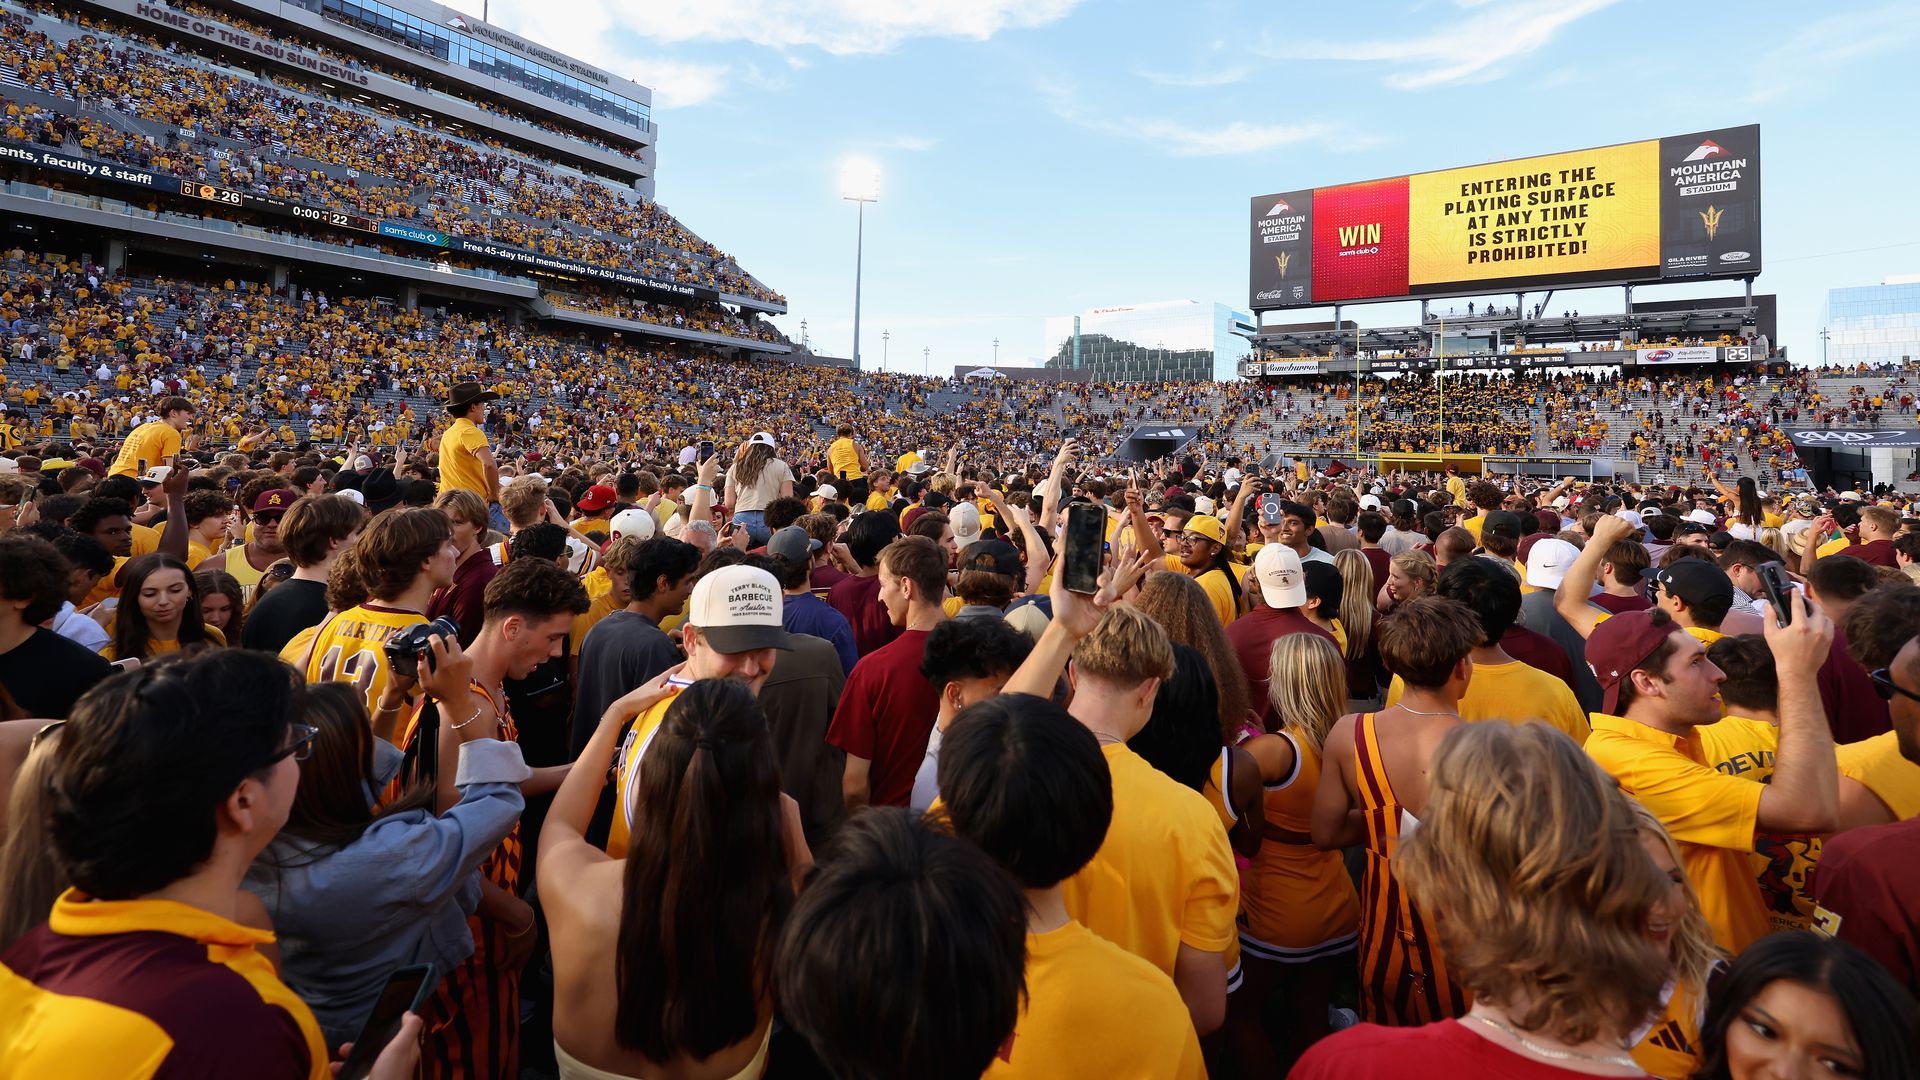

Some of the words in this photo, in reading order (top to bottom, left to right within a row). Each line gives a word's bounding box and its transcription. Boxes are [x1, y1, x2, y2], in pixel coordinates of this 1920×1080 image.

[137, 3, 189, 30] HOME
[192, 21, 215, 36] OF
[219, 30, 250, 49] THE
[253, 42, 284, 59] ASU
[286, 52, 317, 69] SUN
[320, 62, 369, 86] DEVILS
[472, 23, 525, 52] MOUNTAIN
[526, 45, 568, 69] AMERICA
[569, 62, 609, 85] STADIUM
[0, 147, 38, 163] ents,
[43, 153, 97, 175] faculty
[100, 166, 112, 177] &
[115, 169, 152, 184] staff!
[1670, 158, 1747, 177] MOUNTAIN
[1461, 172, 1551, 197] ENTERING
[1559, 166, 1596, 184] THE
[1675, 169, 1742, 186] AMERICA
[1686, 182, 1732, 195] STADIUM
[221, 191, 240, 203] 26
[1444, 195, 1521, 216] PLAYING
[1527, 182, 1616, 206] SURFACE
[293, 206, 320, 219] 0:00
[332, 213, 348, 225] 22
[1467, 215, 1488, 230] AT
[1496, 209, 1532, 226] ANY
[1540, 203, 1589, 222] TIME
[1258, 215, 1306, 228] MOUNTAIN
[384, 225, 408, 237] sam's
[408, 231, 426, 240] club
[1261, 224, 1302, 236] AMERICA
[1339, 223, 1381, 248] WIN
[1469, 233, 1487, 247] IS
[1492, 222, 1586, 245] STRICTLY
[1267, 234, 1297, 243] STADIUM
[1356, 246, 1369, 254] club
[1468, 240, 1587, 264] PROHIBITED!
[463, 241, 483, 253] Free
[484, 246, 516, 260] 45-day
[517, 253, 534, 263] trial
[536, 258, 587, 275] membership
[587, 266, 599, 275] for
[600, 269, 615, 279] ASU
[616, 274, 648, 287] students,
[649, 279, 672, 291] faculty
[678, 287, 695, 296] staff!
[1728, 348, 1748, 360] 25
[1400, 361, 1409, 369] 26
[1457, 358, 1473, 367] 0:00
[1520, 357, 1532, 366] 22
[1248, 365, 1260, 375] 25
[731, 584, 750, 593] TERRY
[729, 593, 773, 602] BARBECUE
